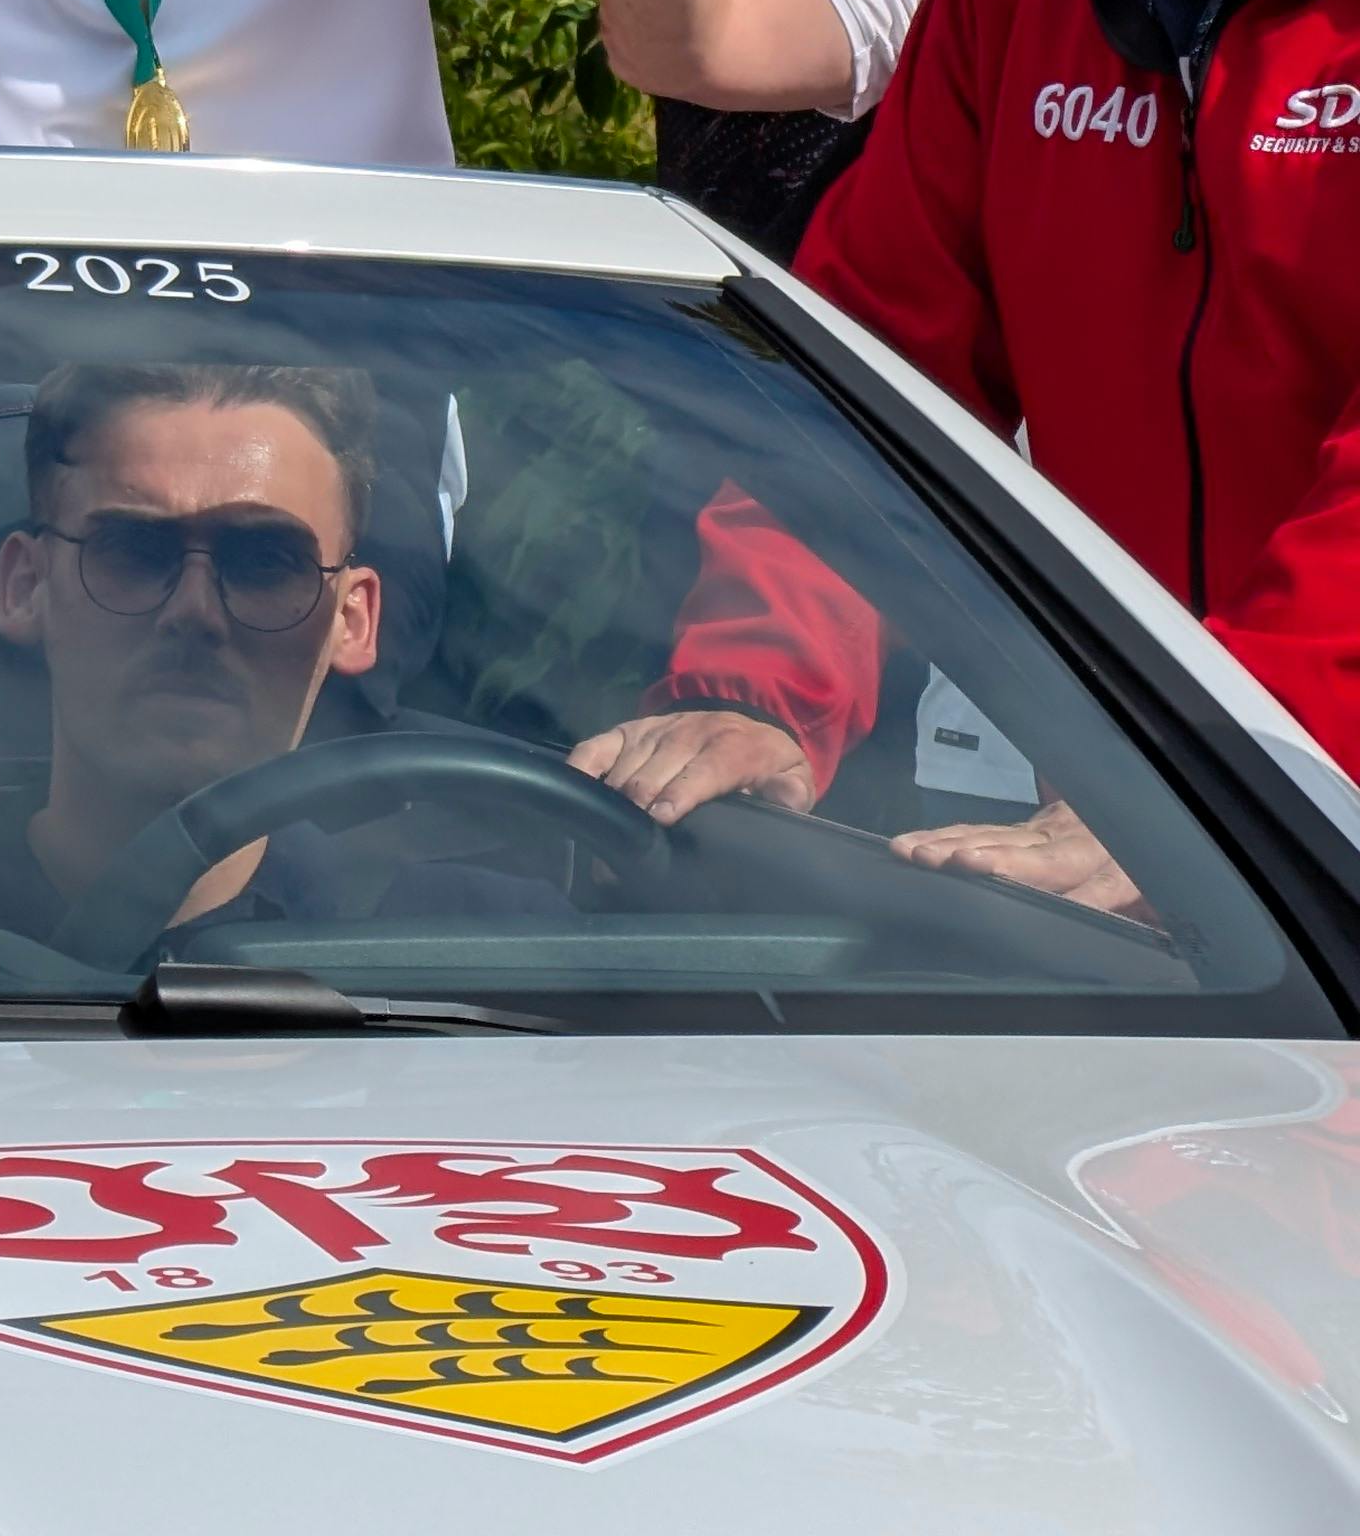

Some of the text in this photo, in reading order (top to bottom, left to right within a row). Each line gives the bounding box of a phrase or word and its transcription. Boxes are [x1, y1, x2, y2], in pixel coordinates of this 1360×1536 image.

[1033, 82, 1158, 148] 6040
[1275, 83, 1360, 129] SD
[1250, 133, 1331, 154] SECURITY
[1332, 136, 1346, 153] &
[14, 251, 252, 303] 2025
[83, 1258, 676, 1294] 18 93
